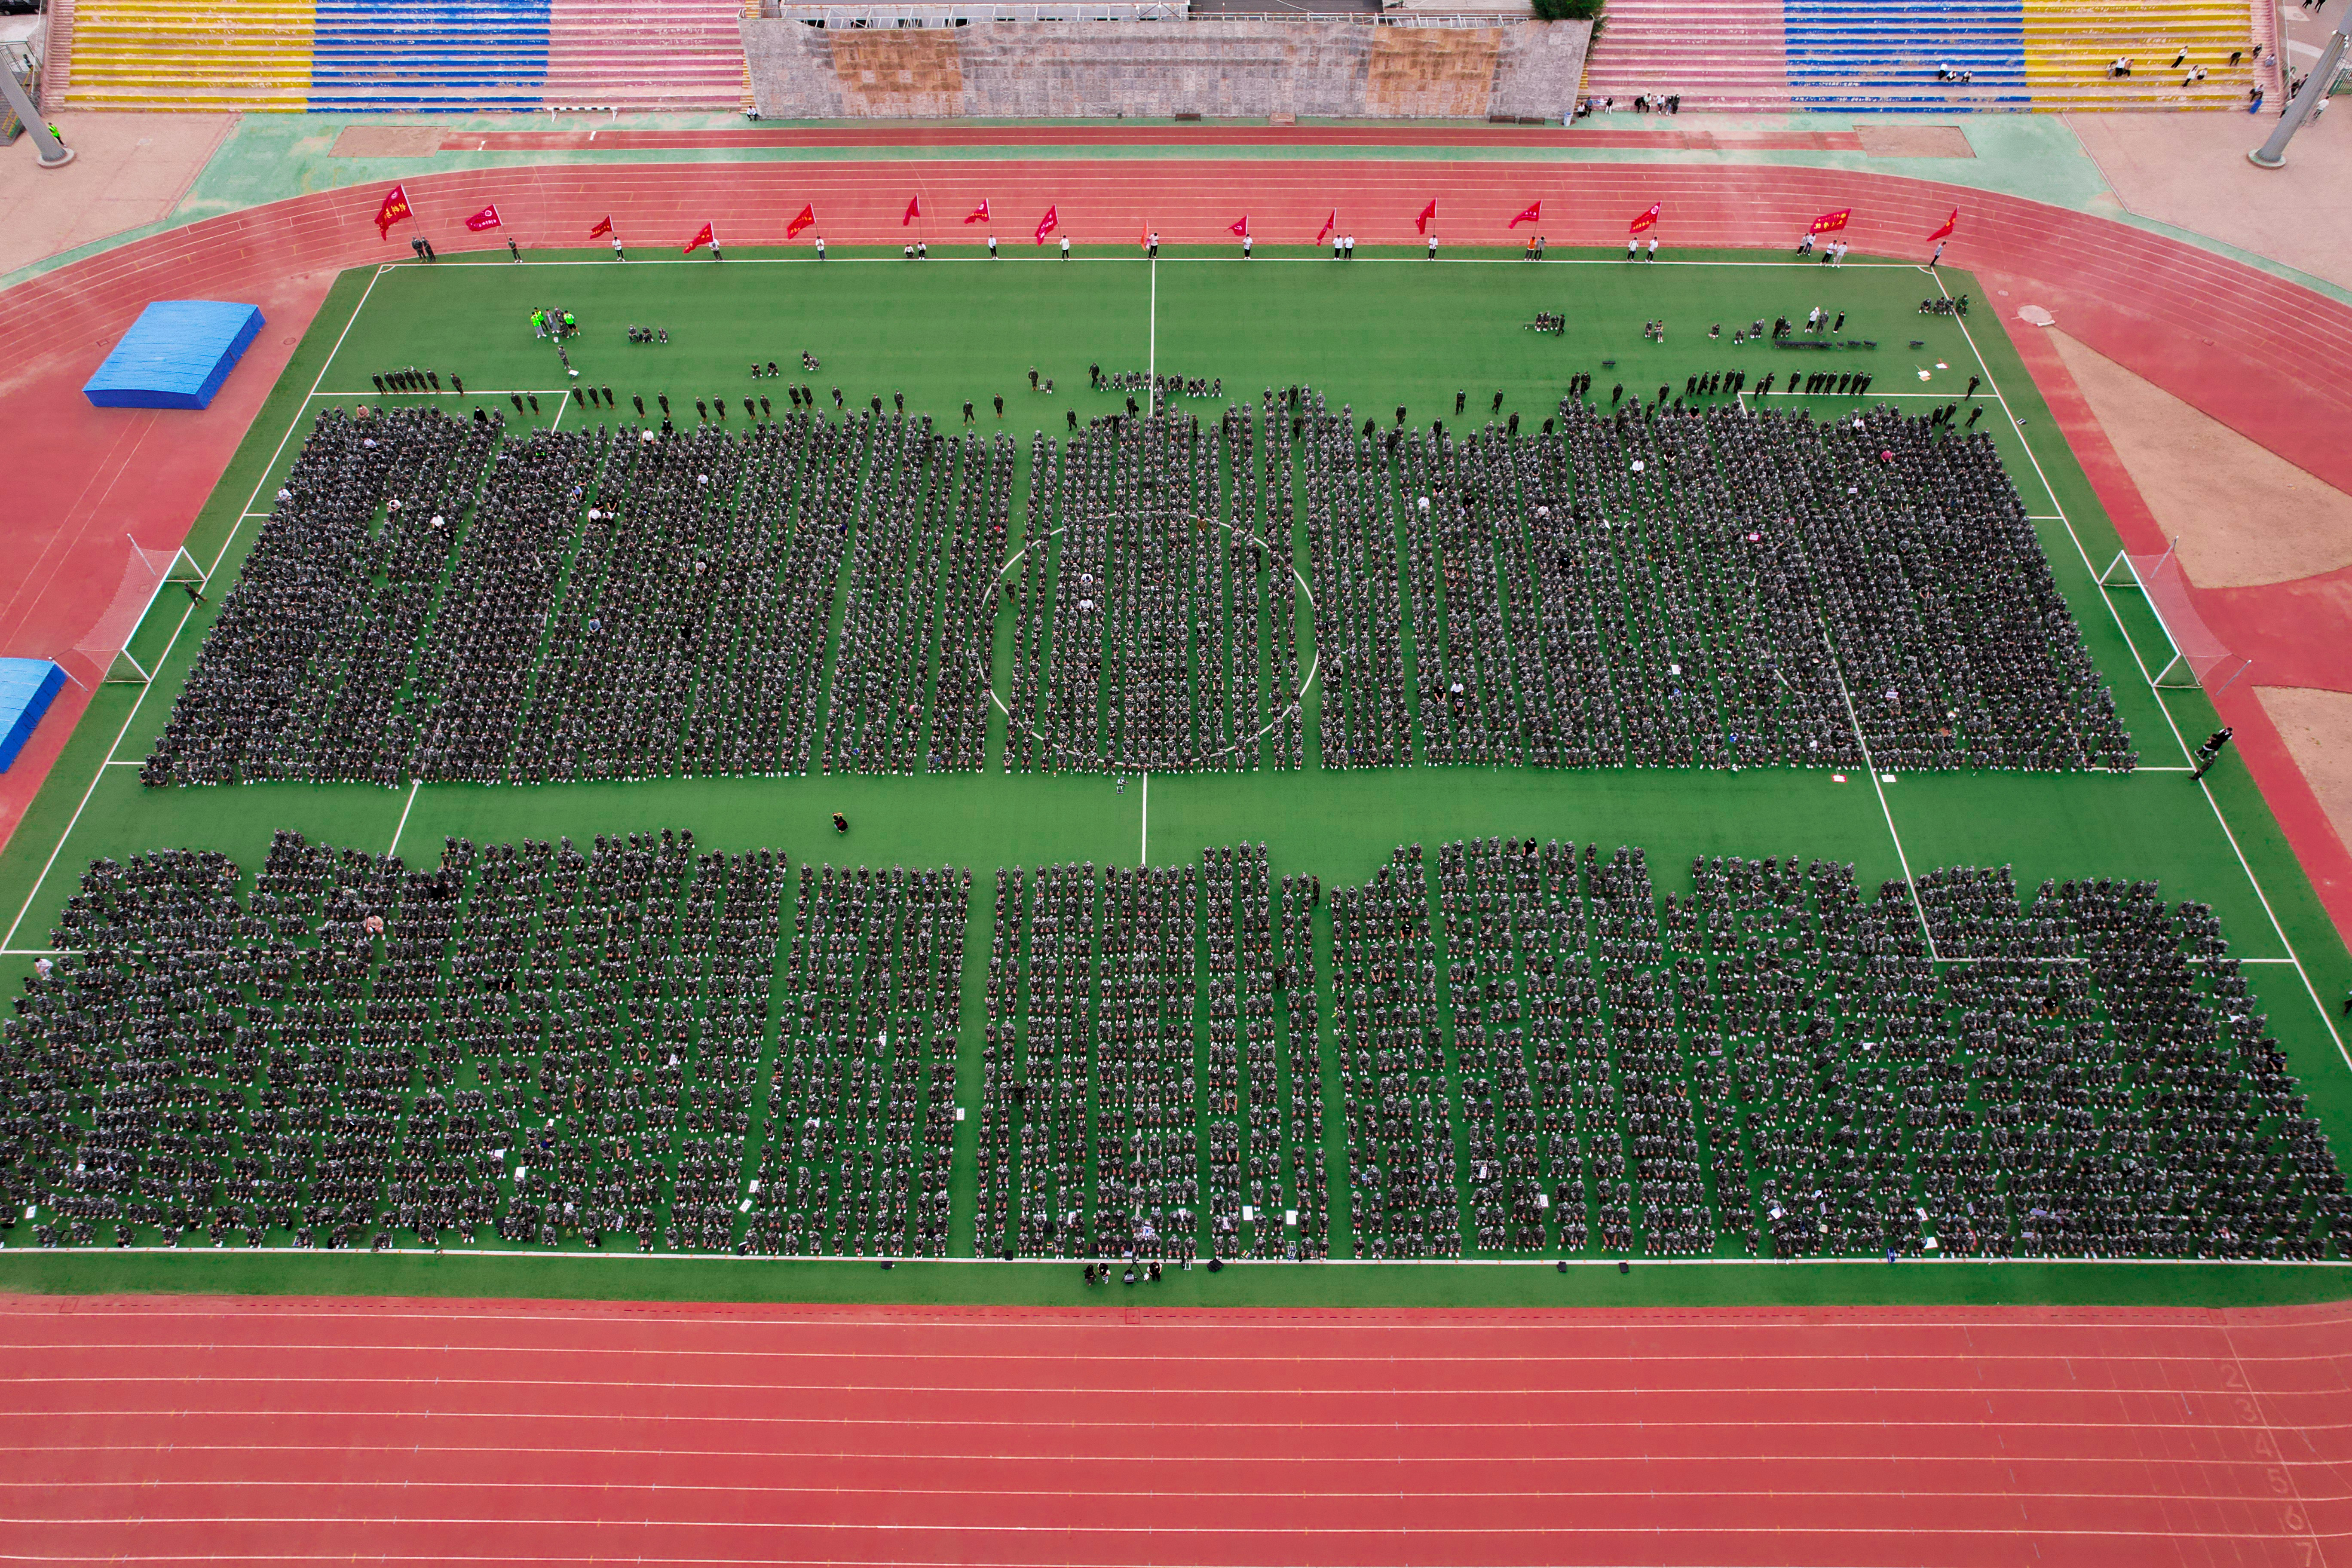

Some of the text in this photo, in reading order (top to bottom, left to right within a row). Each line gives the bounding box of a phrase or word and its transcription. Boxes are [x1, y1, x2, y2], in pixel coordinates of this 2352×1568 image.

[2220, 1364, 2243, 1387] 2
[2235, 1398, 2257, 1422] 3
[2256, 1433, 2273, 1458] 4
[2267, 1468, 2288, 1494] 5
[2285, 1505, 2303, 1531] 6
[2296, 1541, 2312, 1568] 7
